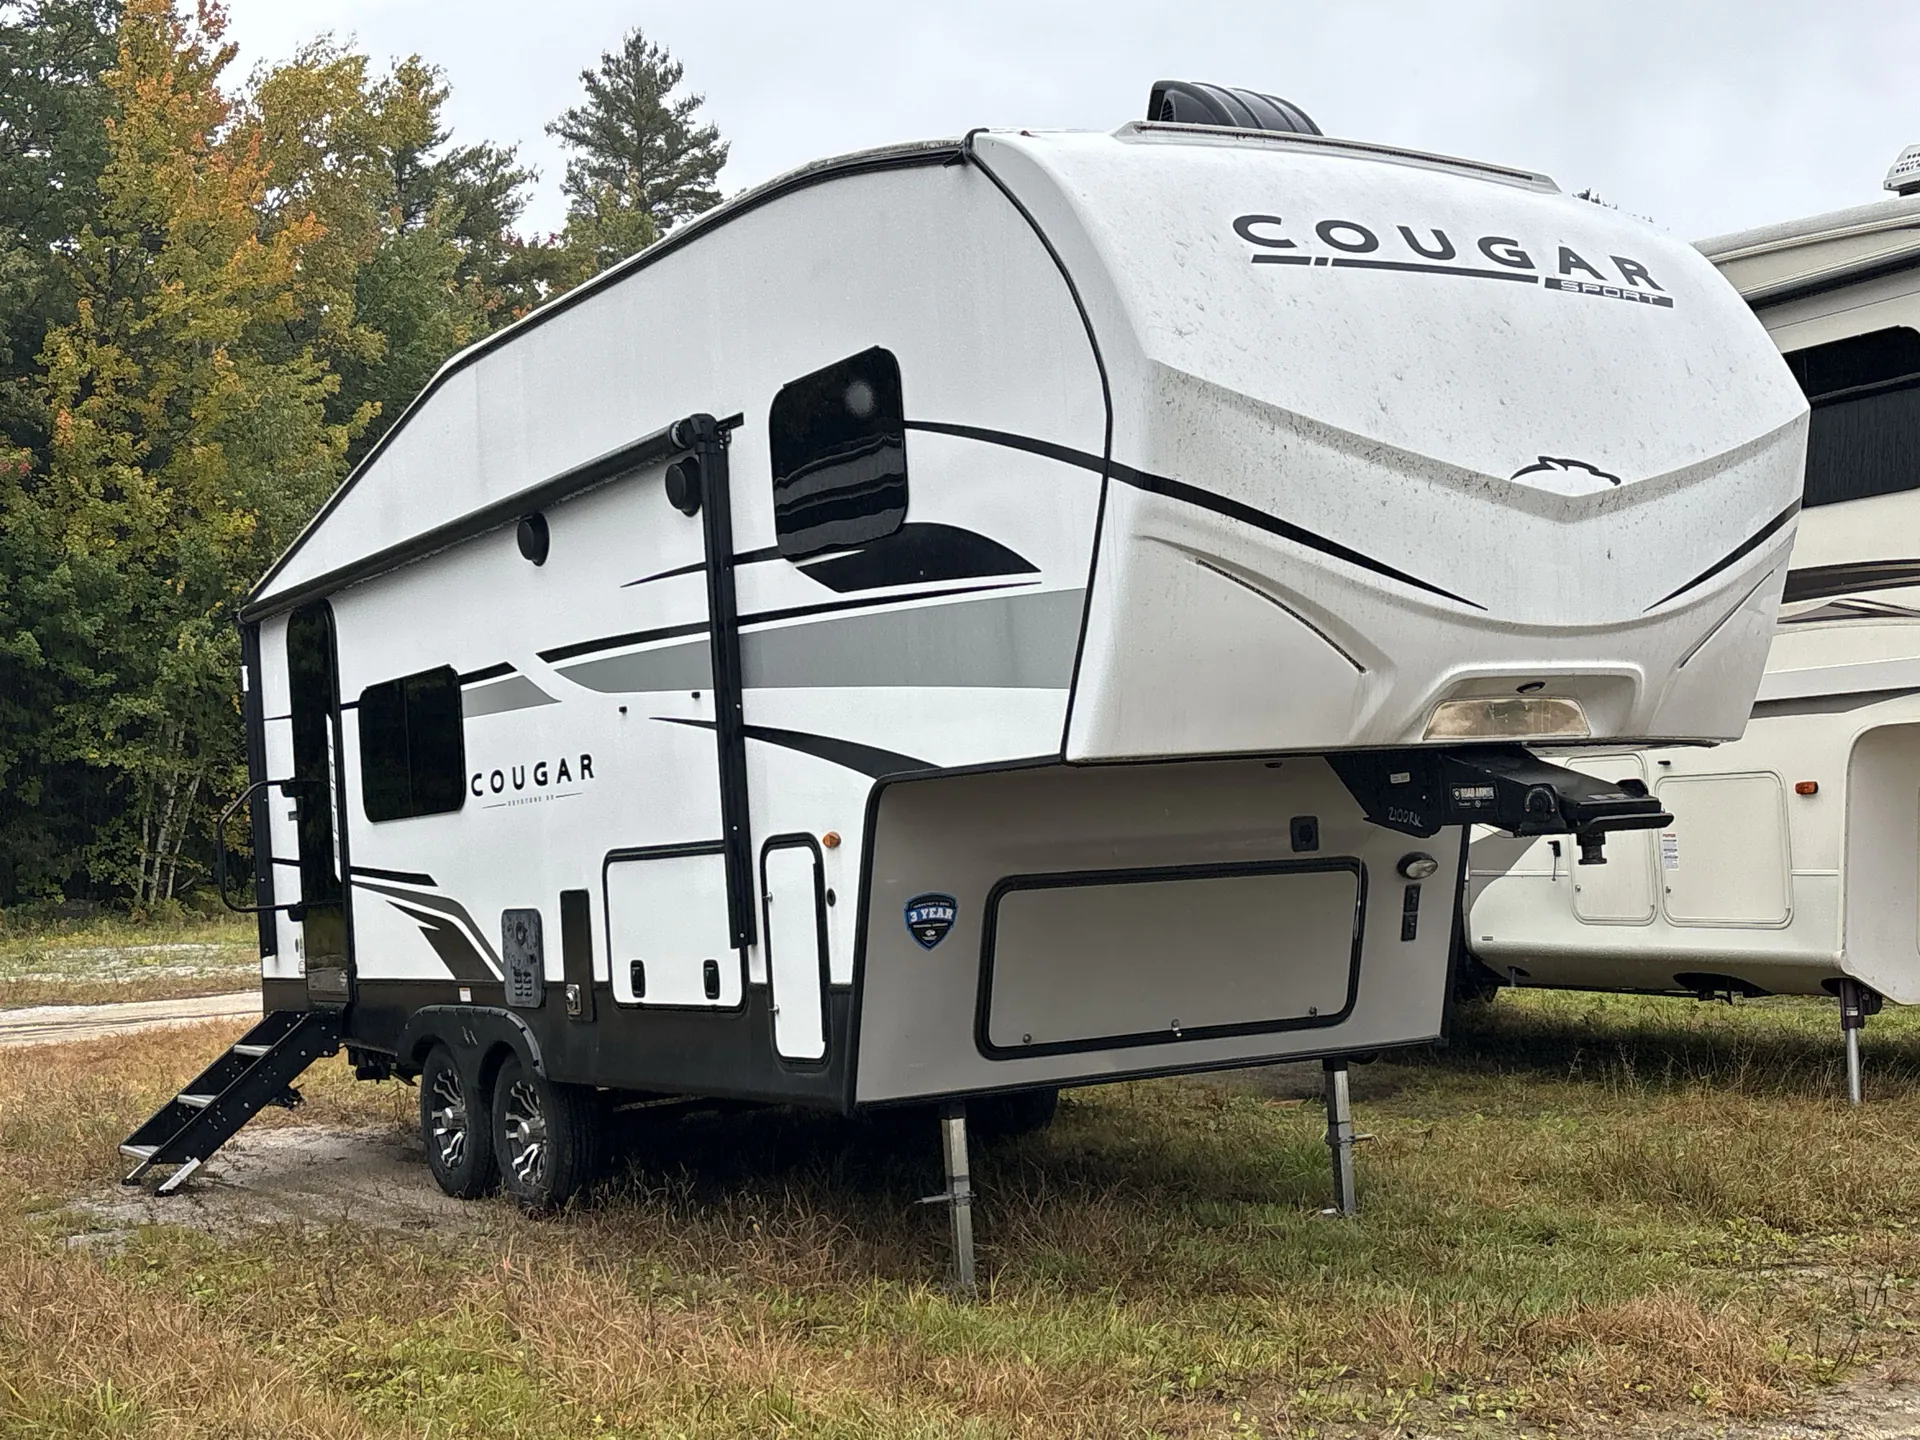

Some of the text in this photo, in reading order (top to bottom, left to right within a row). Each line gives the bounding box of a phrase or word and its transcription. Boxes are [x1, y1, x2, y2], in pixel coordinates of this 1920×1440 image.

[1232, 214, 1665, 292] COUGAR
[1560, 279, 1660, 304] SPORT
[470, 753, 595, 797] COUGAR
[910, 907, 954, 922] 3 YEAR
